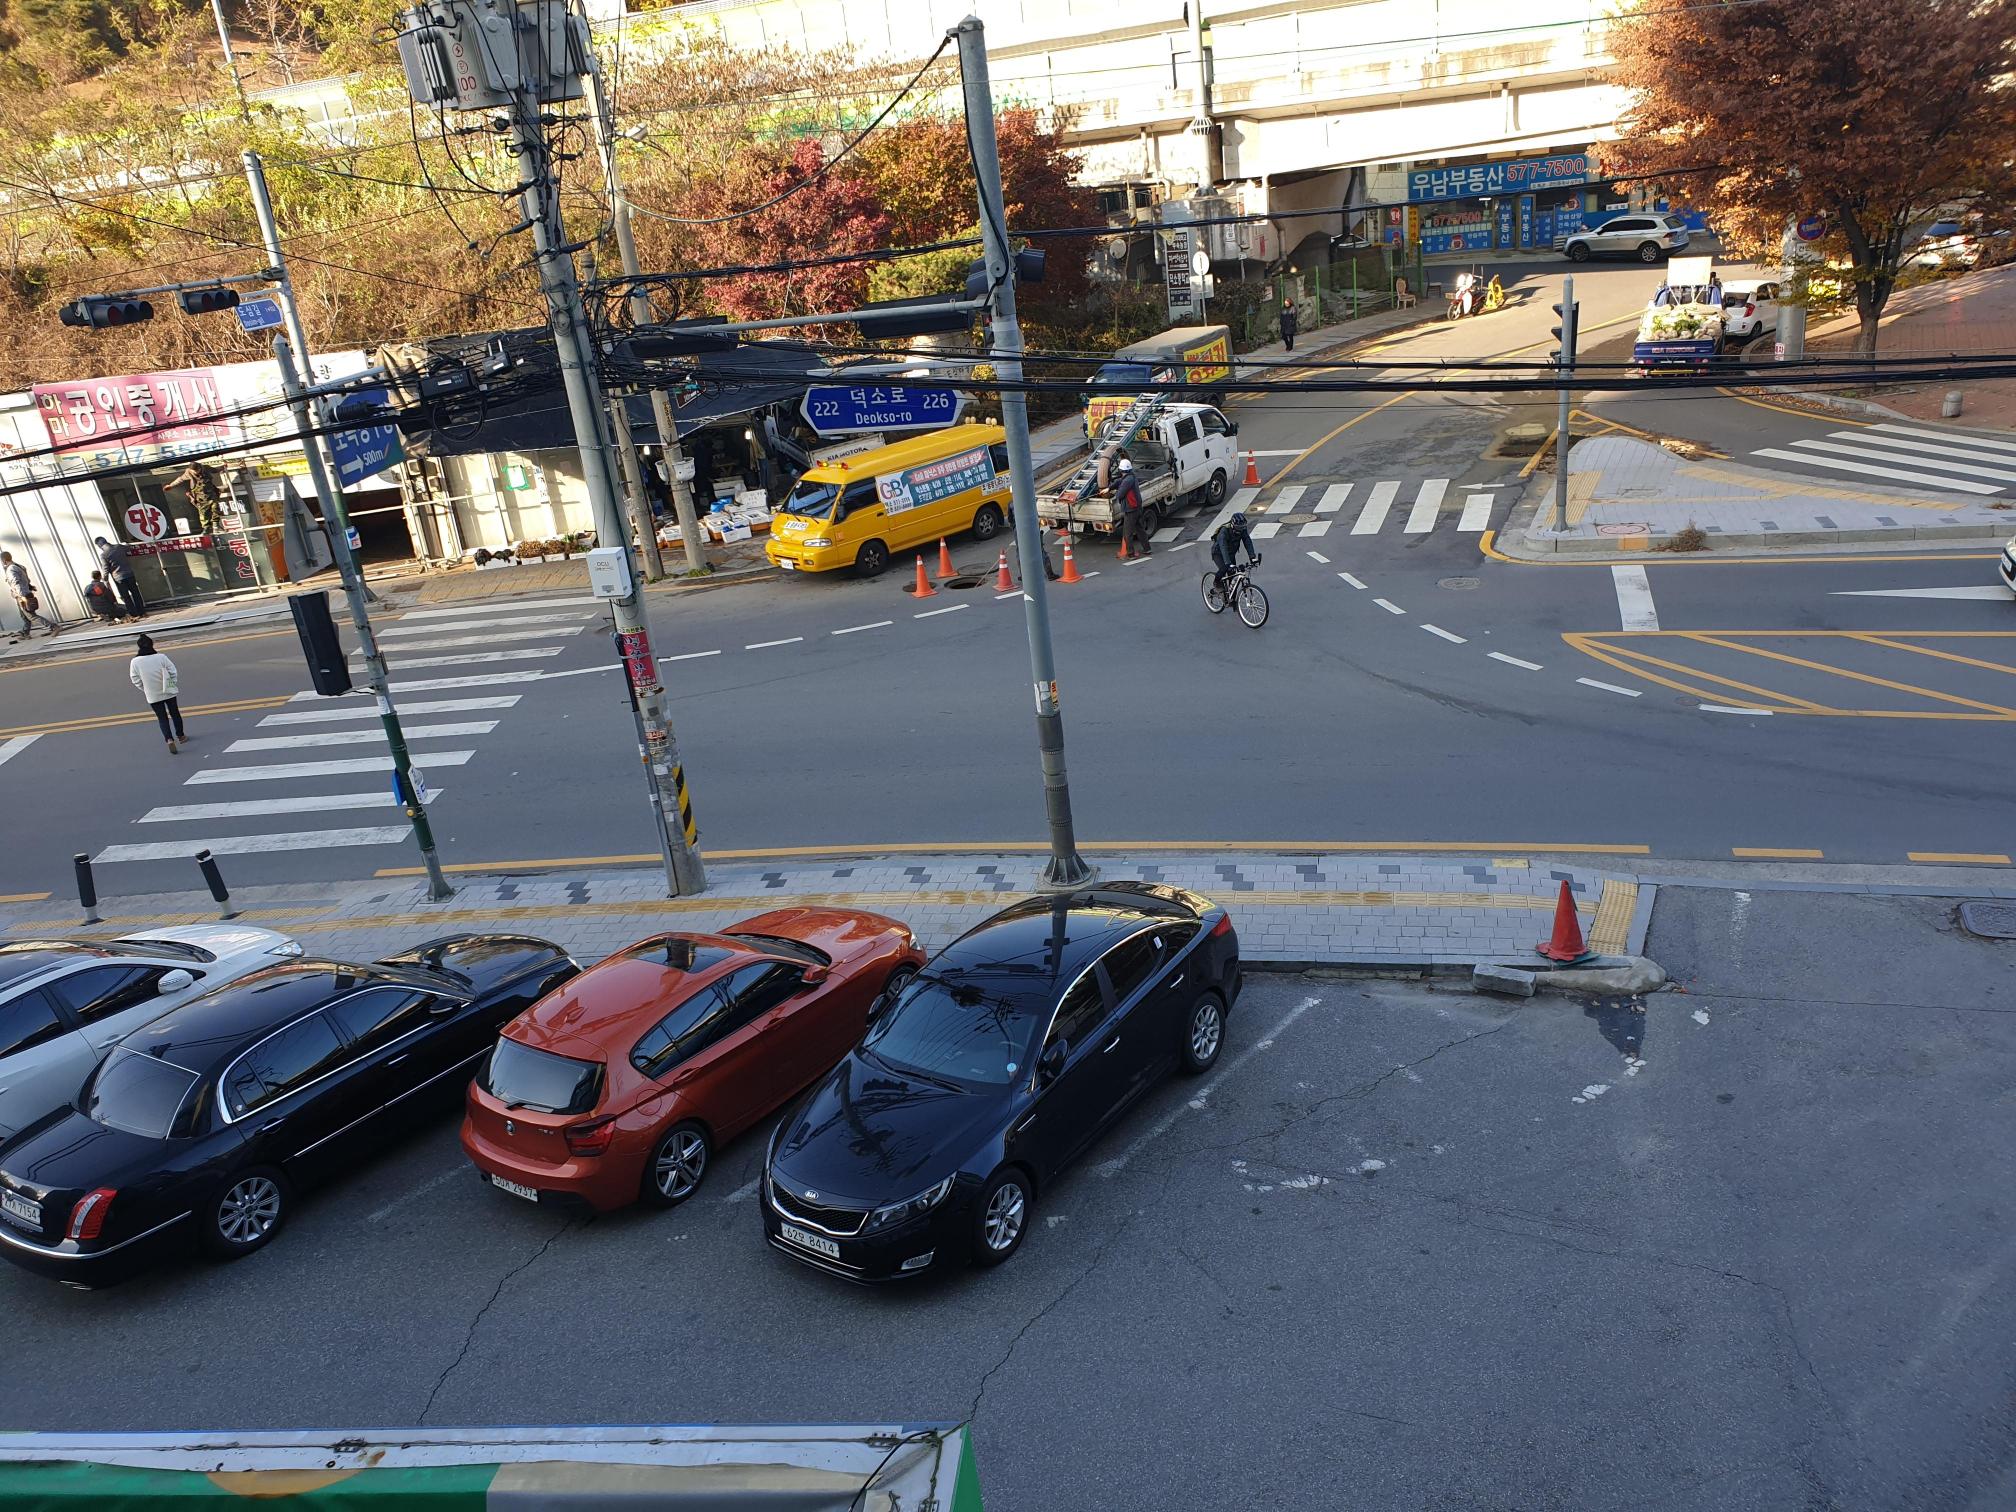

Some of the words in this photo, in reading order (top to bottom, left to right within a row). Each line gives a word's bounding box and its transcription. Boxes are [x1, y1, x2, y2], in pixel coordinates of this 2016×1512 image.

[458, 76, 476, 91] 100
[1412, 165, 1504, 198] 우남부동산
[1507, 157, 1585, 182] 577-7500
[64, 377, 219, 436] 공인중개사
[850, 387, 908, 409] 덕소로
[922, 393, 949, 409] 226
[813, 401, 840, 417] 222
[855, 411, 913, 425] Deokso-ro
[95, 448, 145, 469] 577
[362, 449, 384, 466] 500m
[805, 1191, 817, 1199] KIA
[809, 1235, 834, 1254] 8414
